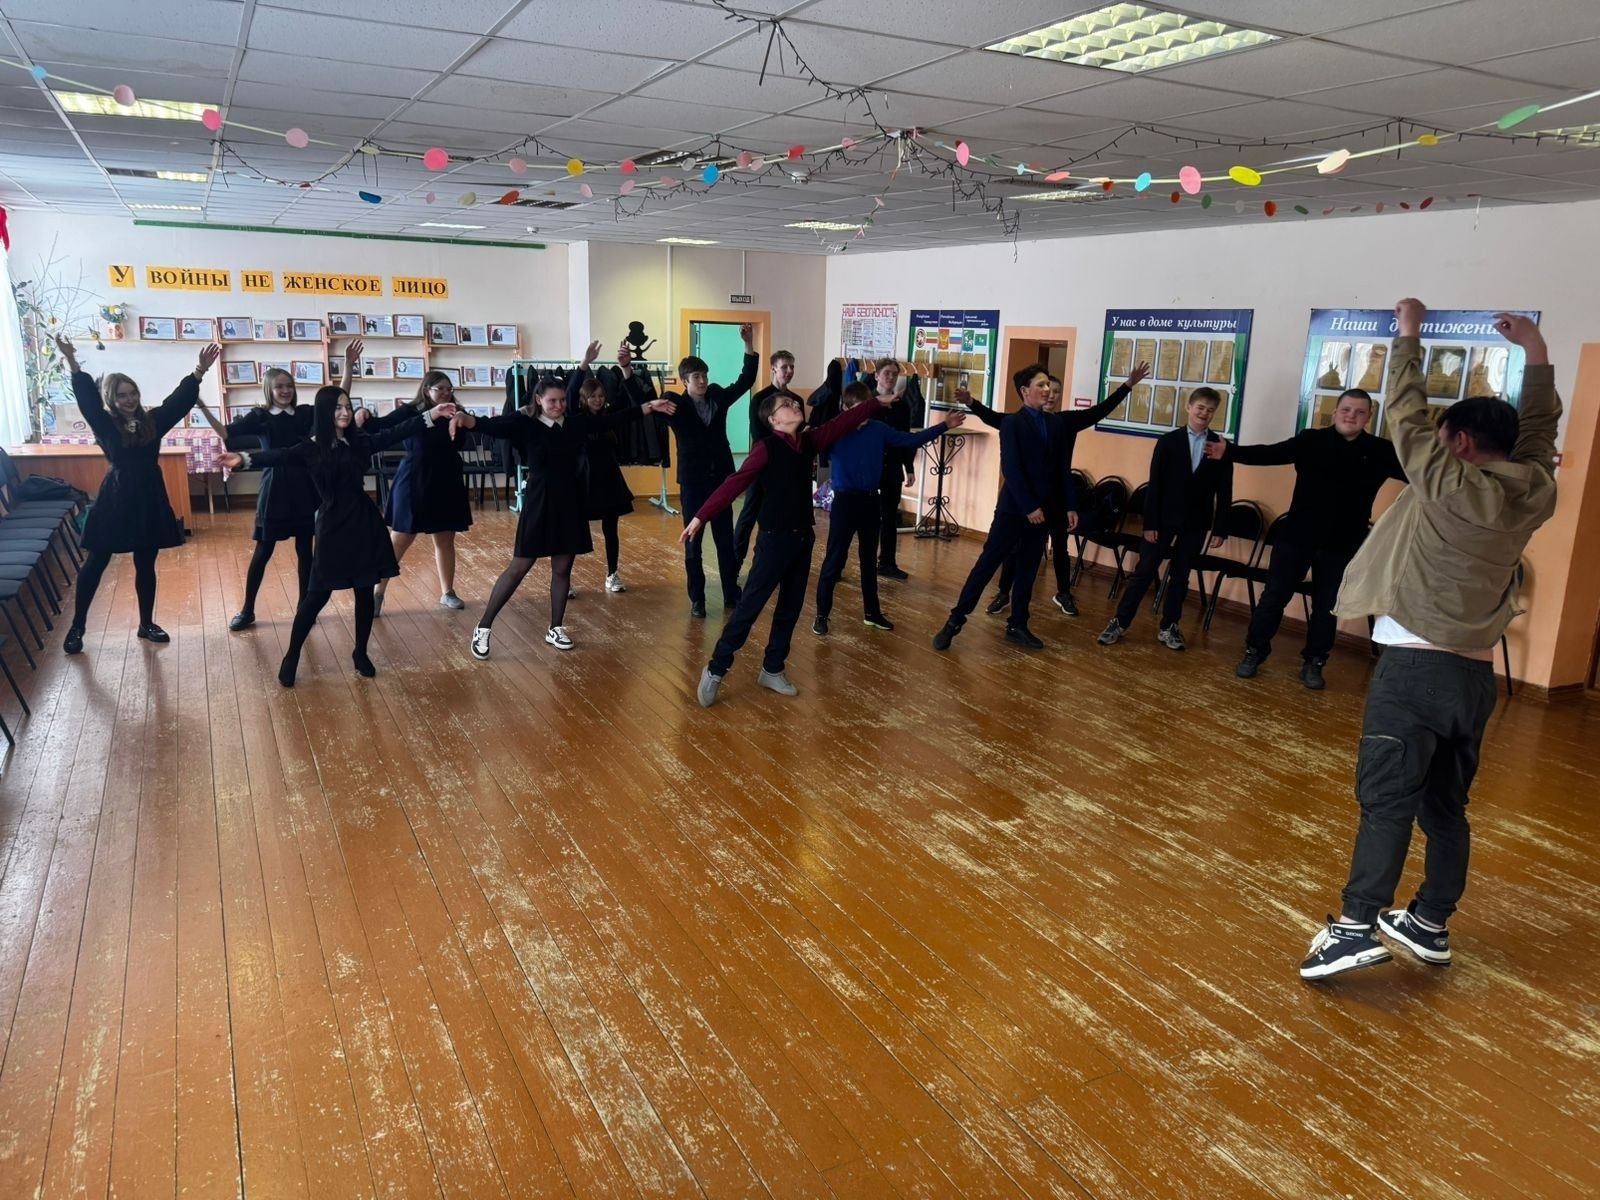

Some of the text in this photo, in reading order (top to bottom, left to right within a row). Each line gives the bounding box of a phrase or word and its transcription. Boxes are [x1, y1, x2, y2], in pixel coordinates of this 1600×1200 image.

[112, 265, 446, 295] У ВОЙНЫ НЕ ЖЕНСКОЕ ЛИЦО
[1111, 316, 1237, 331] У нас в доме культуры
[1330, 317, 1501, 335] Наши дтижени
